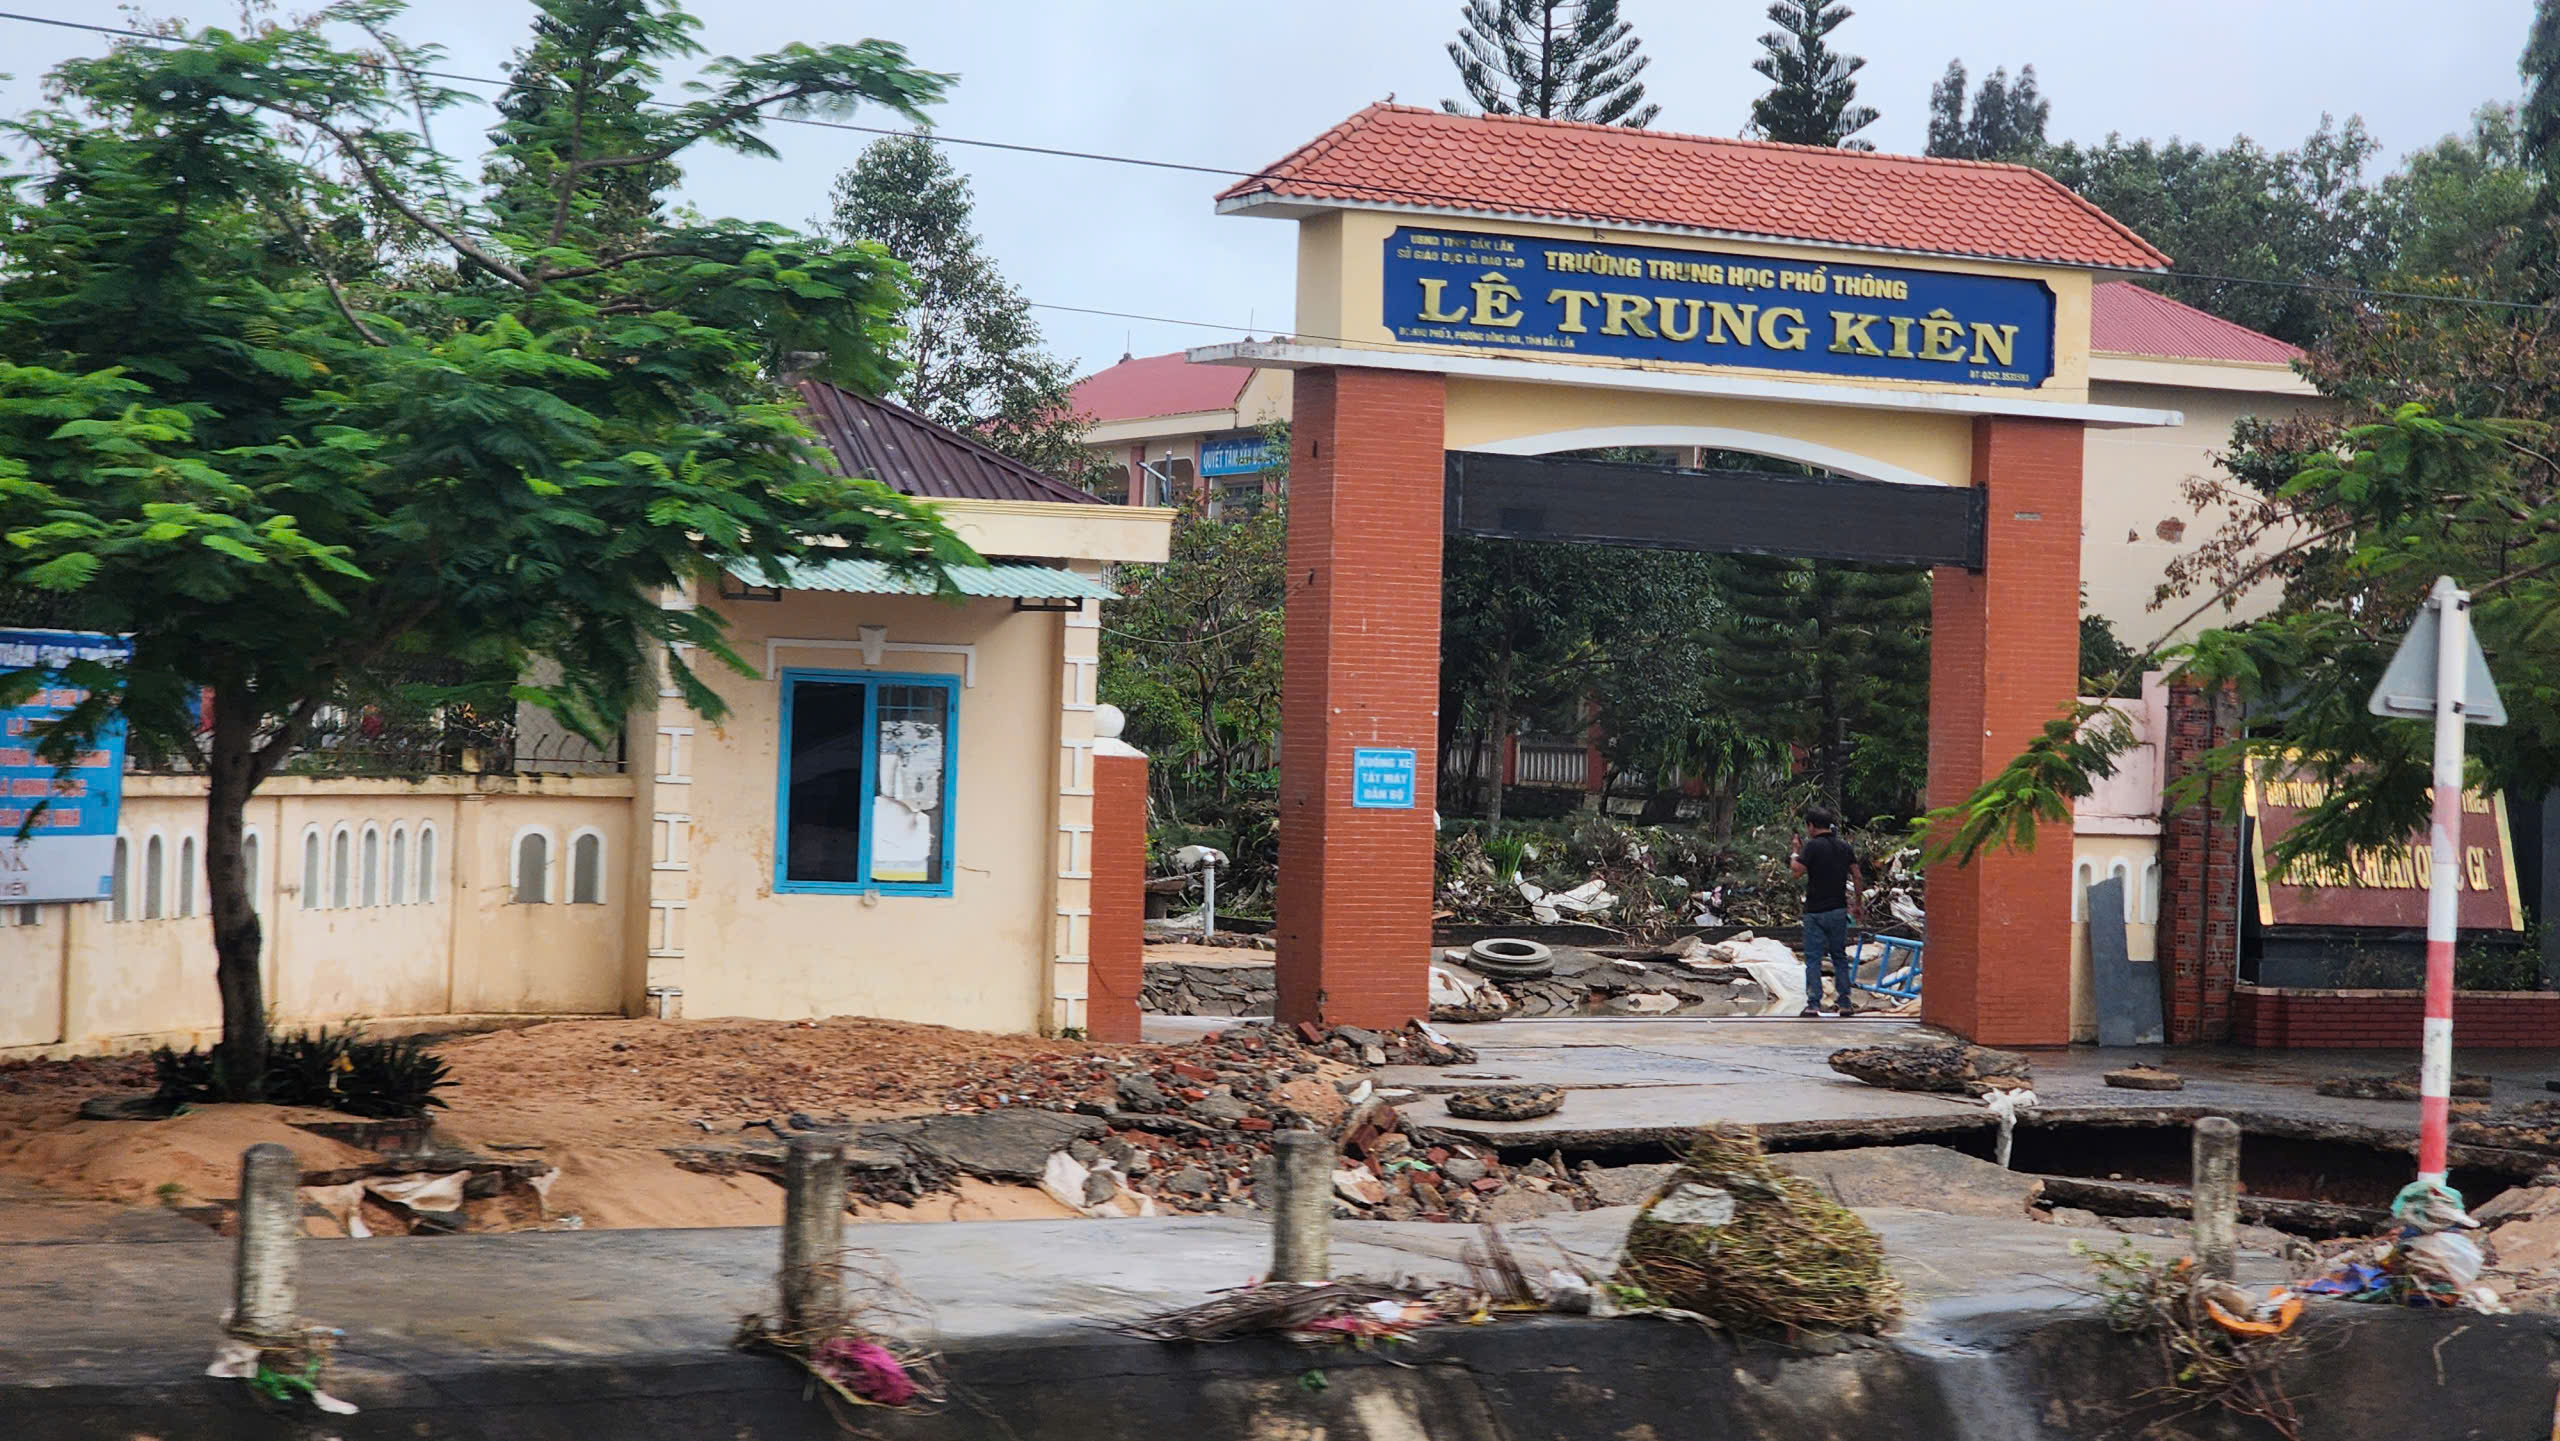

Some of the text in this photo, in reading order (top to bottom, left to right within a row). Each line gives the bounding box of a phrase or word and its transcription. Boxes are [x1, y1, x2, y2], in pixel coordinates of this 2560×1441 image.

[1413, 248, 1439, 261] GIÁO
[1543, 250, 1908, 300] TRƯỜNG TRUNG HỌC PHỔ THÔNG
[1417, 271, 2020, 366] LÊ TRUNG KIÊN
[2302, 782, 2324, 808] CHO
[2465, 845, 2494, 890] GI
